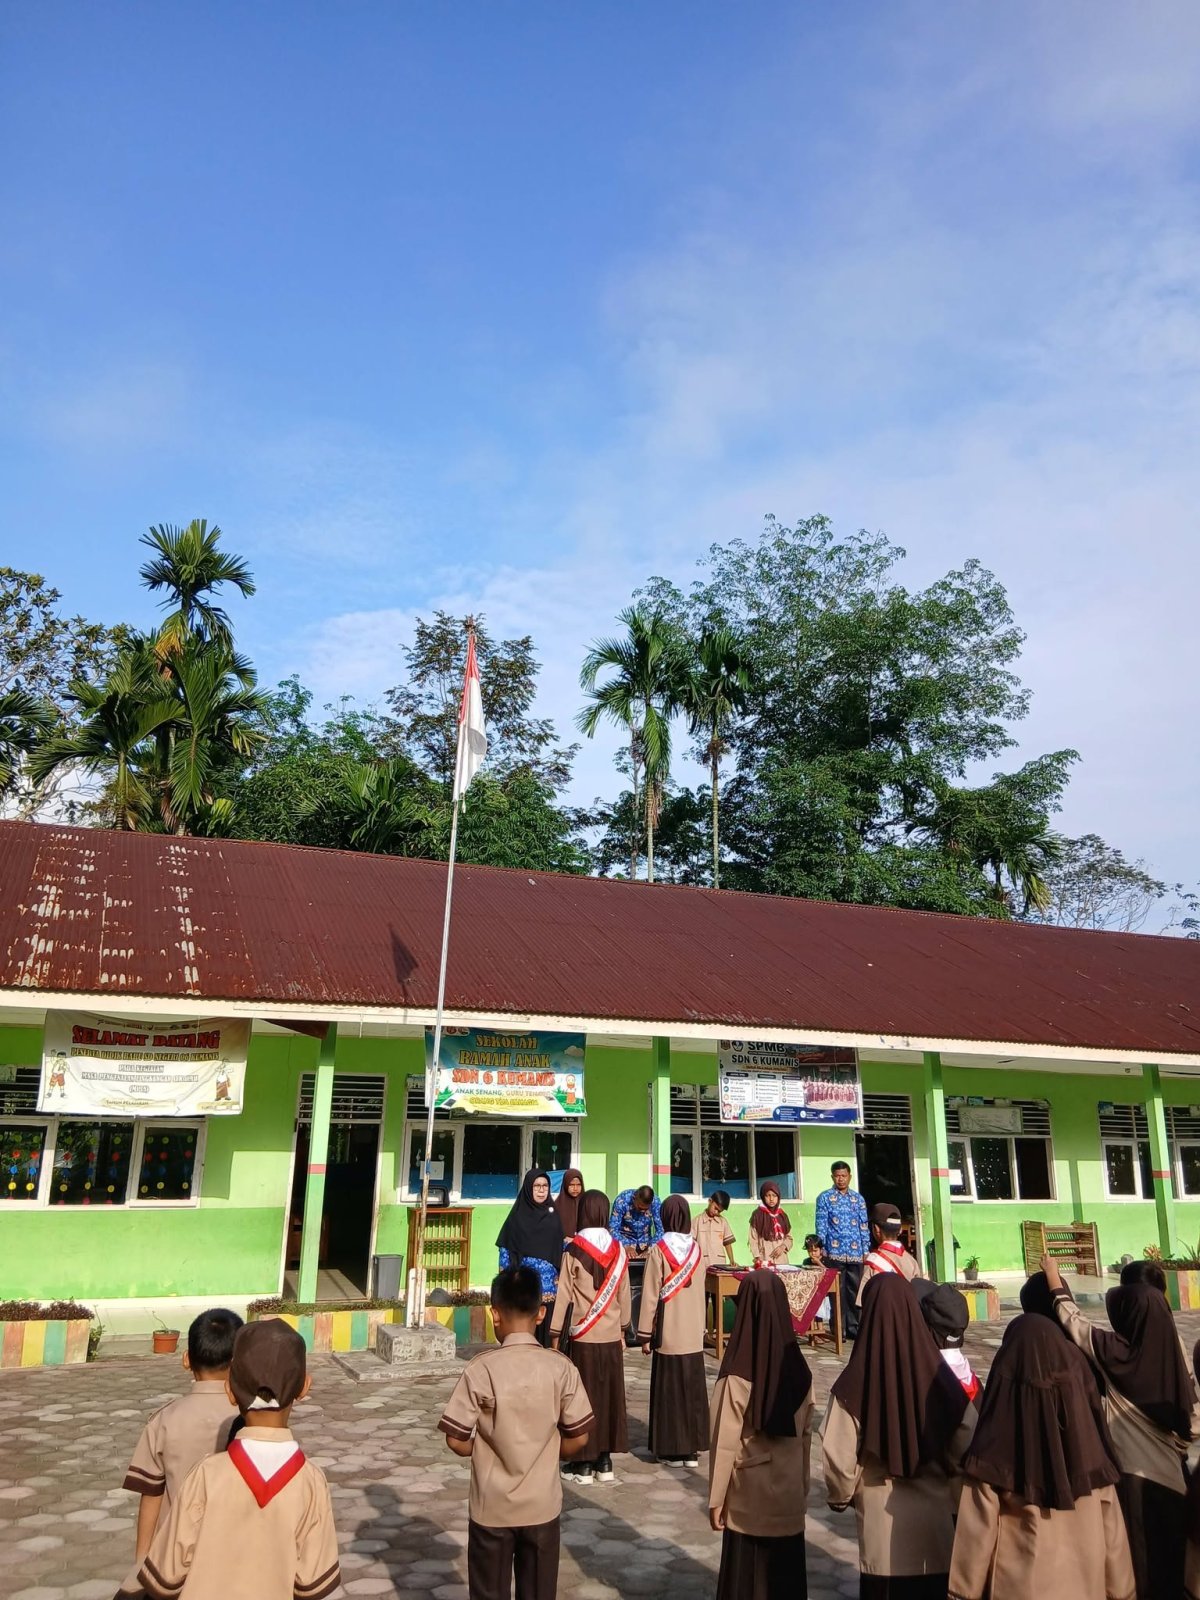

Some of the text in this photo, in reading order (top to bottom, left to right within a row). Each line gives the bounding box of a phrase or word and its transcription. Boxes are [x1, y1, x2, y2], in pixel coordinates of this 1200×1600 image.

[72, 1025, 220, 1048] SELAMAT DATANG
[476, 1034, 538, 1049] SEKOLAH
[748, 1041, 786, 1052] SPMB
[459, 1050, 550, 1068] RAMAH ANAK
[732, 1054, 800, 1068] SDN 6 KUMANIS
[452, 1068, 556, 1086] SDN 6 KUMANIS
